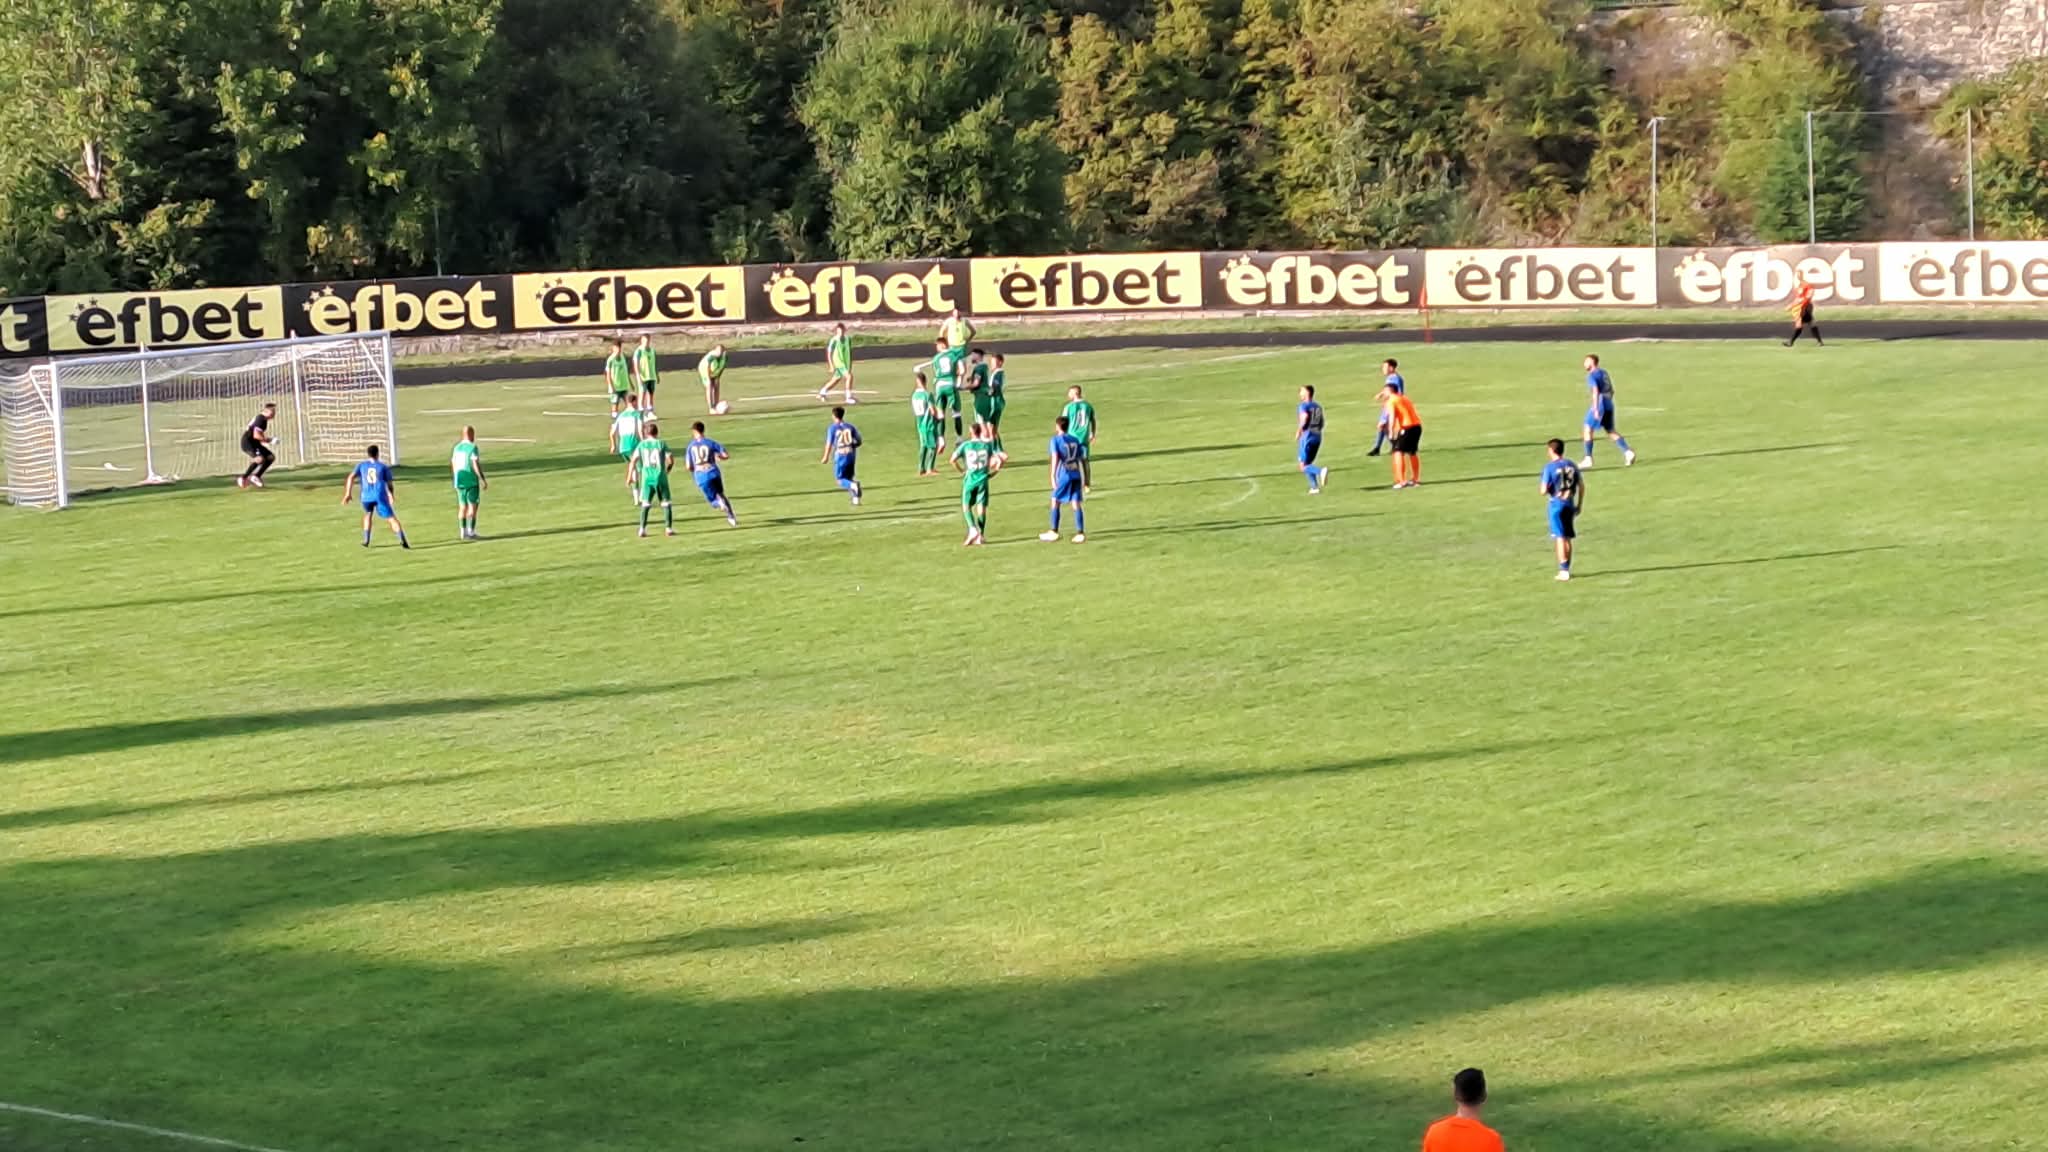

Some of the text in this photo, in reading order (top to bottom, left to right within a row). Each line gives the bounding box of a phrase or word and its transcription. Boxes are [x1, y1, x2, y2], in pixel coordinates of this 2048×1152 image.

[541, 273, 726, 323] efbet
[770, 265, 955, 316] efbet
[999, 260, 1182, 307] efbet
[1225, 255, 1410, 305] efbet
[1454, 254, 1637, 301] efbet
[1680, 248, 1865, 303] efbet
[76, 293, 265, 346] efbet
[309, 281, 497, 333] efbet
[642, 447, 661, 468] 14
[836, 428, 852, 446] 20
